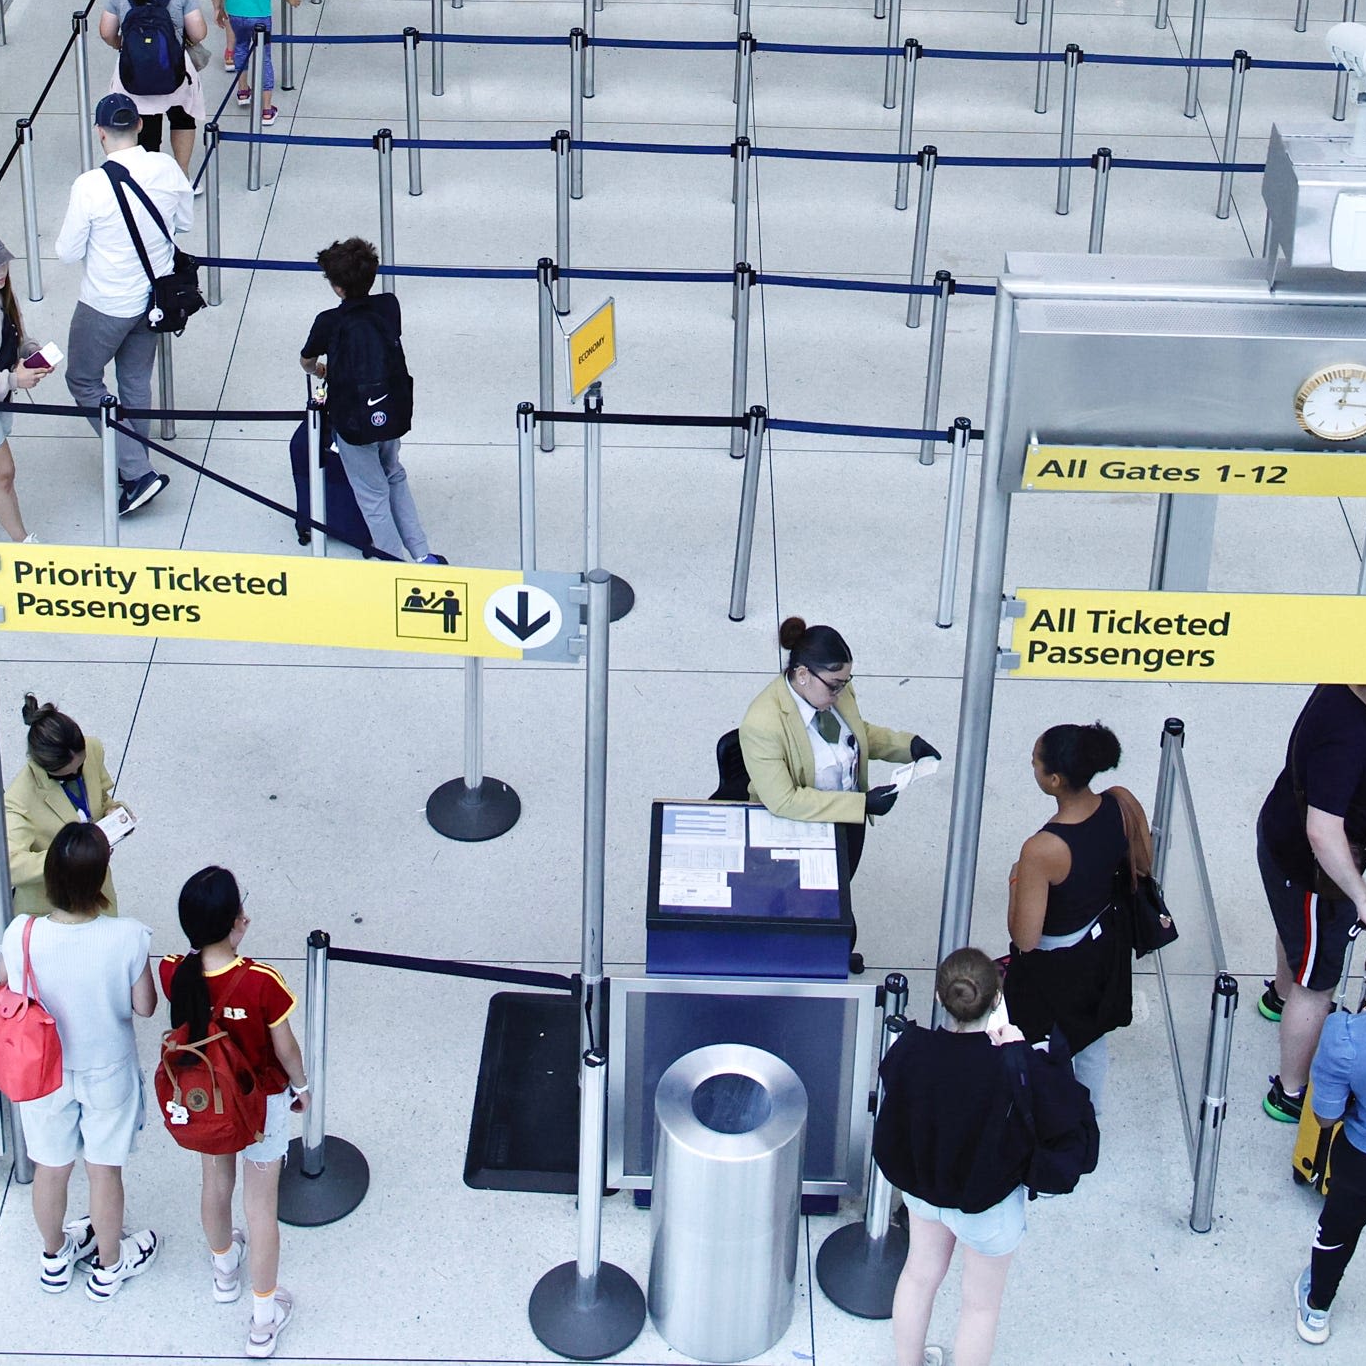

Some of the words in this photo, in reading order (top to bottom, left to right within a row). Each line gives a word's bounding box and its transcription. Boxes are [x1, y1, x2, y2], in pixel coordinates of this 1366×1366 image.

[578, 336, 605, 364] ECONOMY
[1037, 459, 1087, 479] All
[1099, 461, 1201, 482] Gates
[1215, 464, 1289, 484] 1-12
[14, 560, 137, 594] Priority
[146, 564, 288, 596] Ticketed
[17, 592, 201, 626] Passengers
[1029, 608, 1076, 634] All
[1087, 610, 1231, 636] Ticketed
[1028, 640, 1216, 673] Passengers
